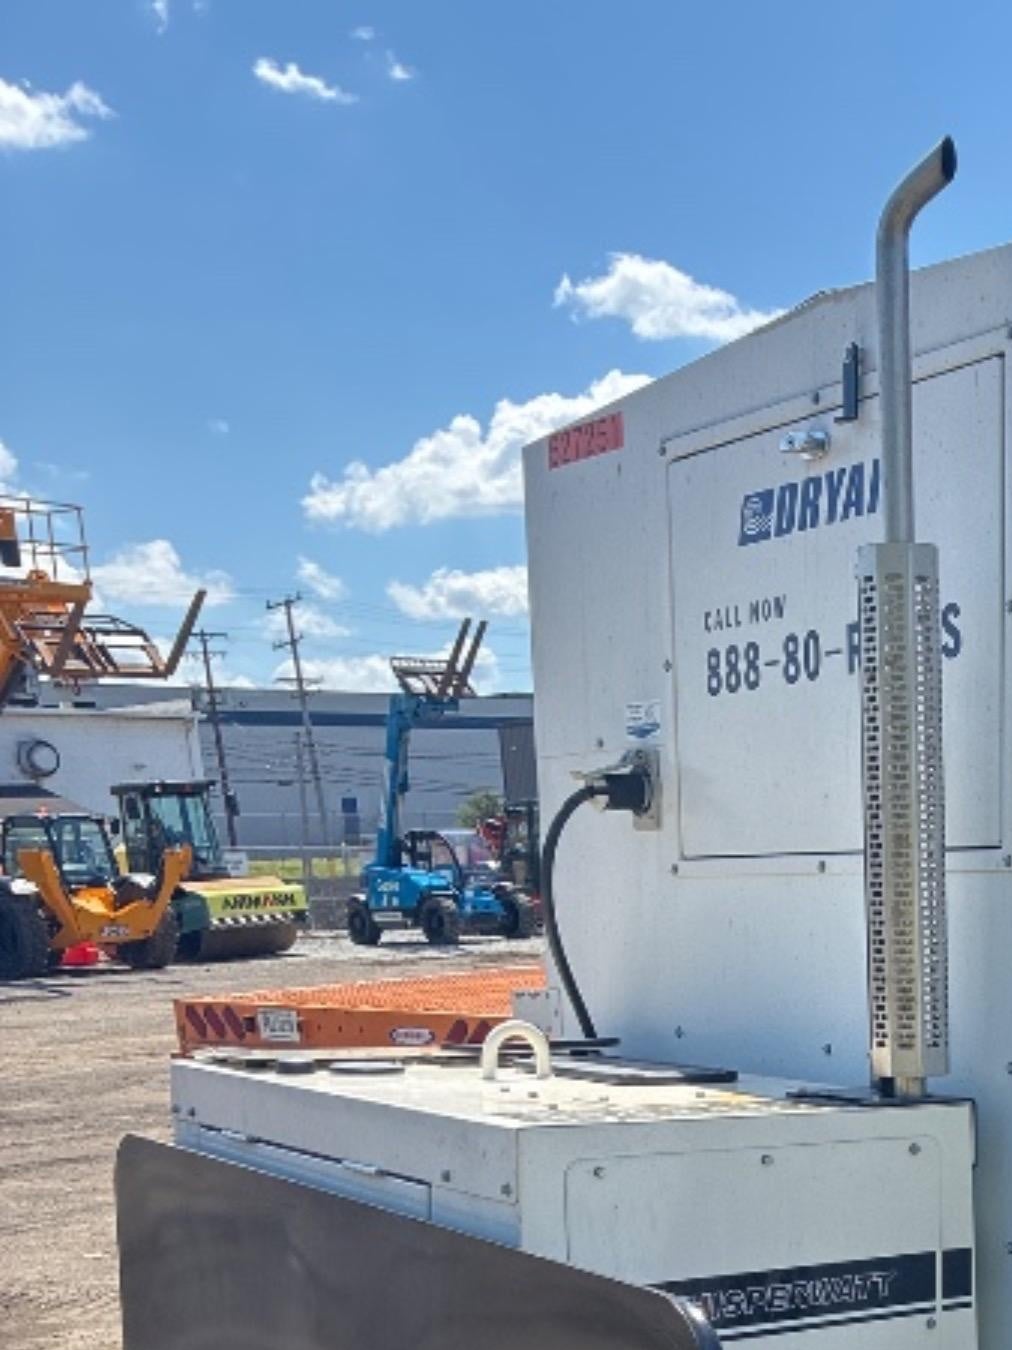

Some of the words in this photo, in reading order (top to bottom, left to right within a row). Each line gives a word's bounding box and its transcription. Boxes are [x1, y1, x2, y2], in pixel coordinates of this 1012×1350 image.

[773, 458, 880, 538] DRYAI
[703, 605, 742, 633] CALL
[749, 594, 787, 625] NOW
[706, 602, 962, 697] 888-80-RS
[699, 1270, 897, 1322] ISPERWATT
